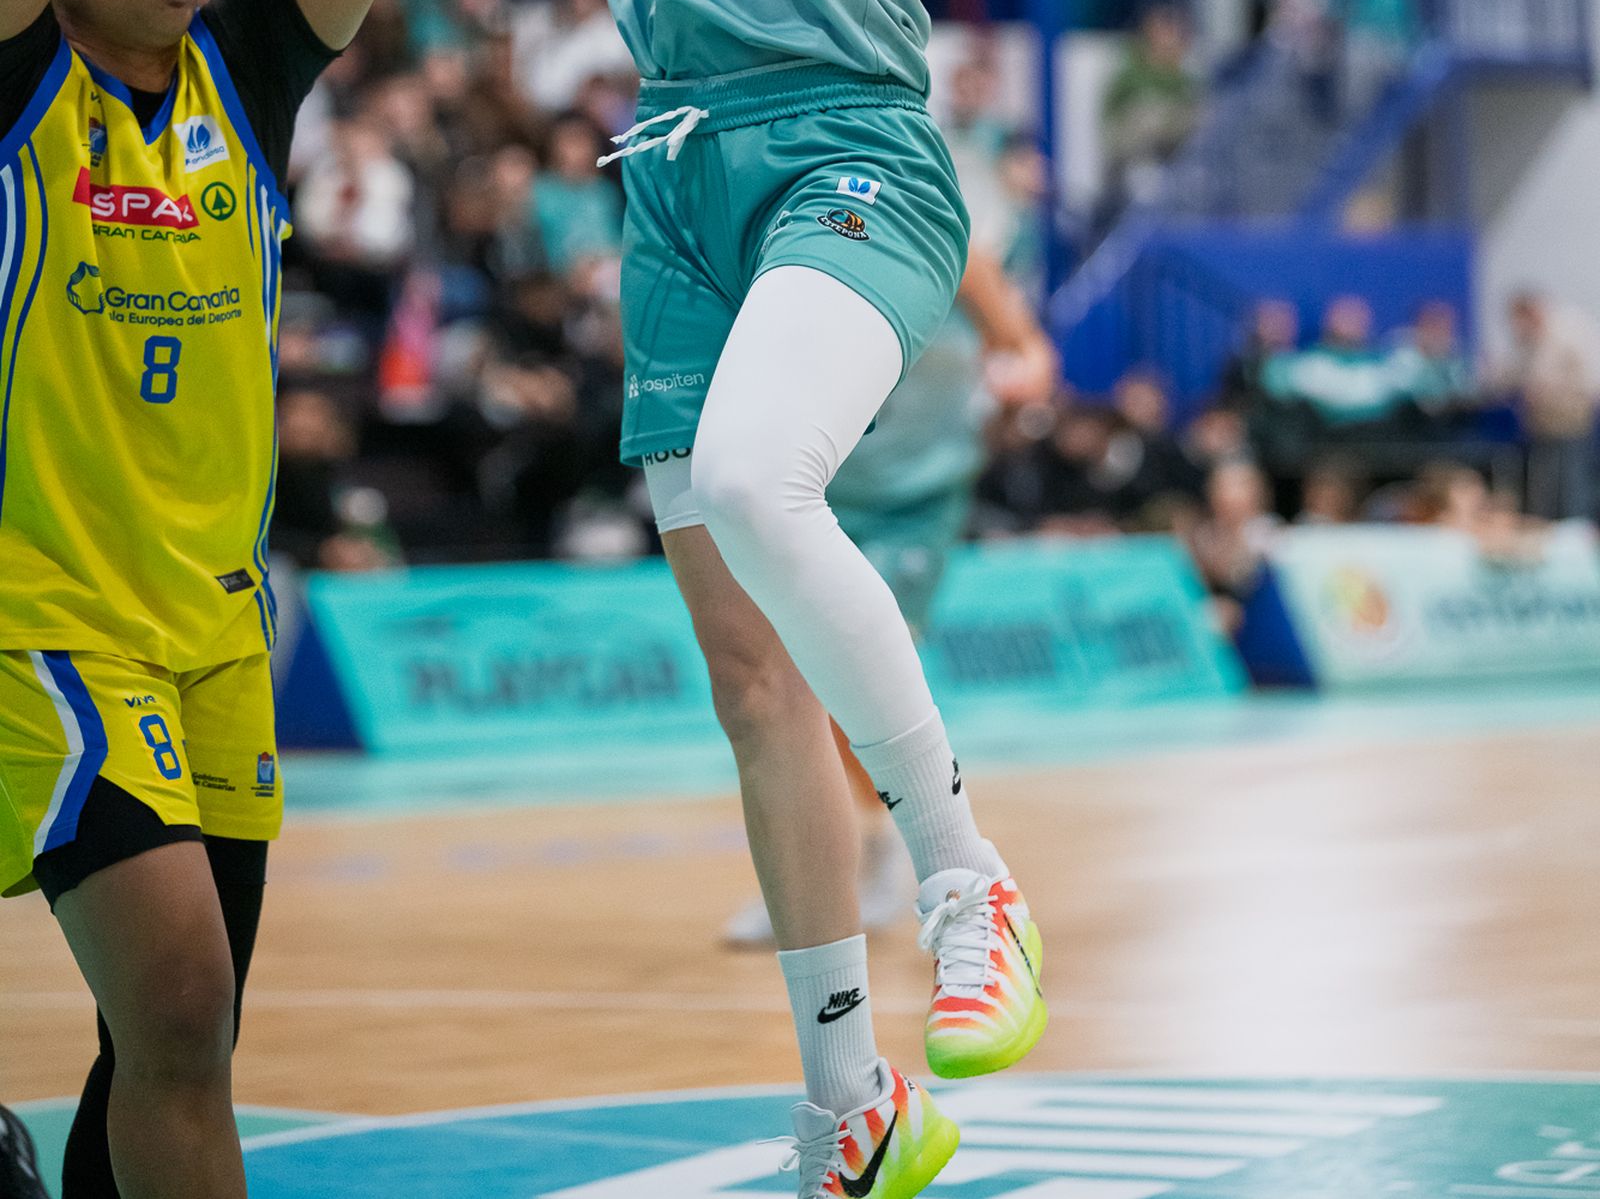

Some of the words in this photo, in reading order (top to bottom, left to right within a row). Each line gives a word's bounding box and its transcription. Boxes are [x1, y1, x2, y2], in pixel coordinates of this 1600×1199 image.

[105, 286, 165, 311] Gran
[168, 285, 240, 312] Canaria
[128, 311, 184, 327] Europea
[186, 313, 206, 326] del
[208, 308, 242, 324] Deporte
[140, 335, 182, 404] 8
[644, 447, 692, 467] HOO
[139, 714, 182, 780] 8
[827, 988, 860, 1009] NIKE
